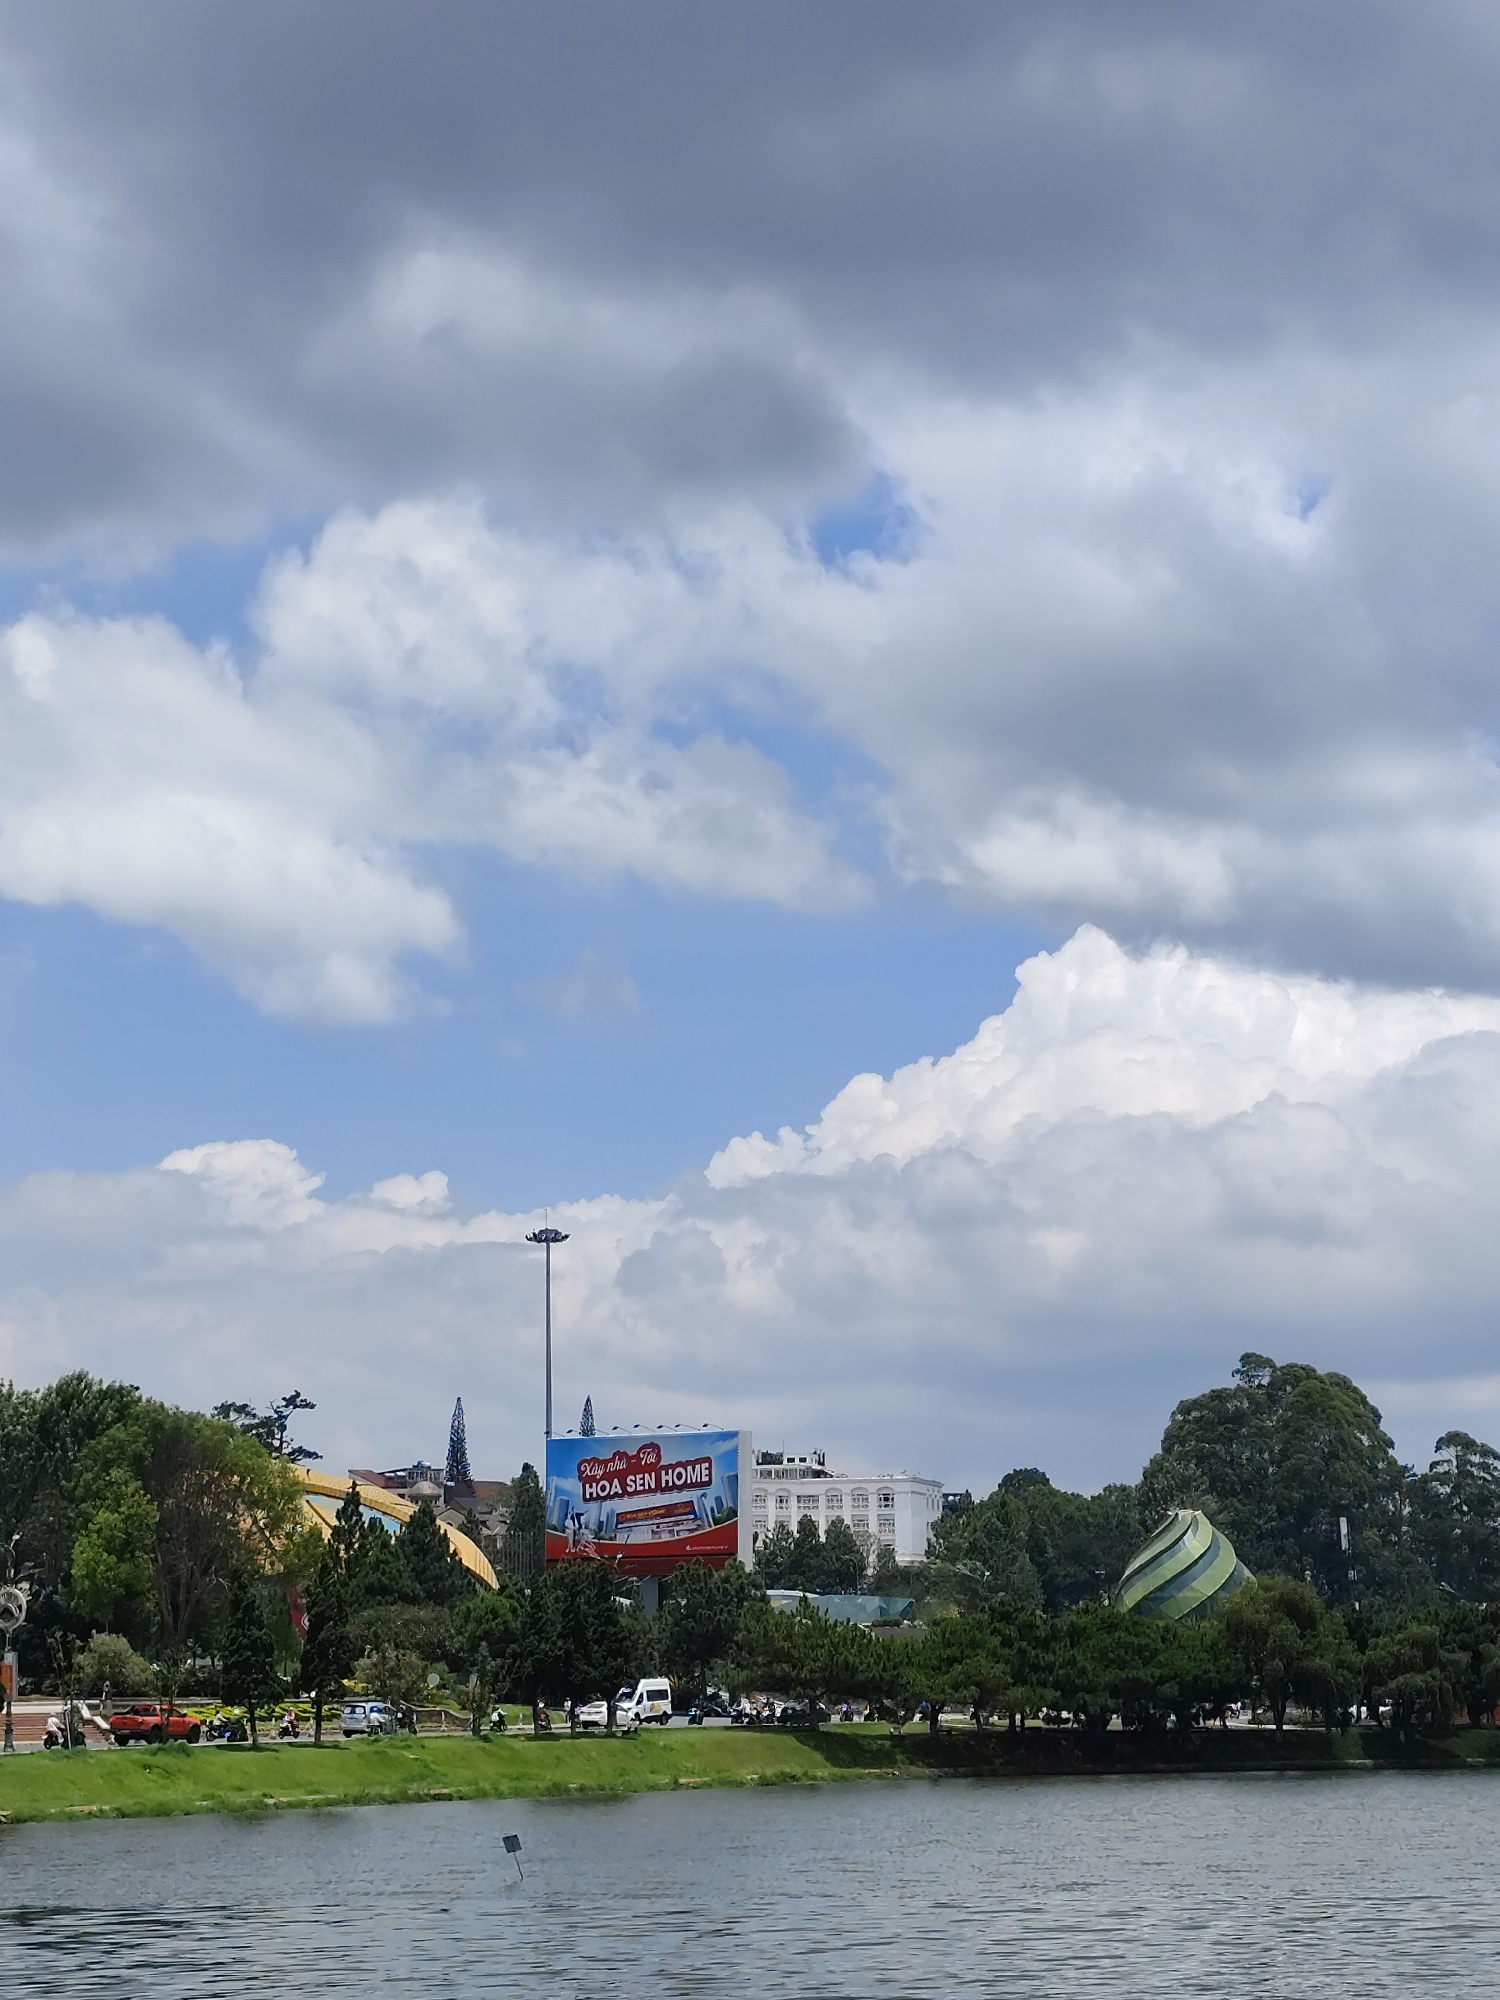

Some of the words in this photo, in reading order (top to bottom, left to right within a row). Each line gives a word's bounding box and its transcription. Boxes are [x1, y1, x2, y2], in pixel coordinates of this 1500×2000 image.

[585, 1478, 623, 1499] HOA
[626, 1471, 656, 1492] SEN
[661, 1462, 710, 1488] HOME
